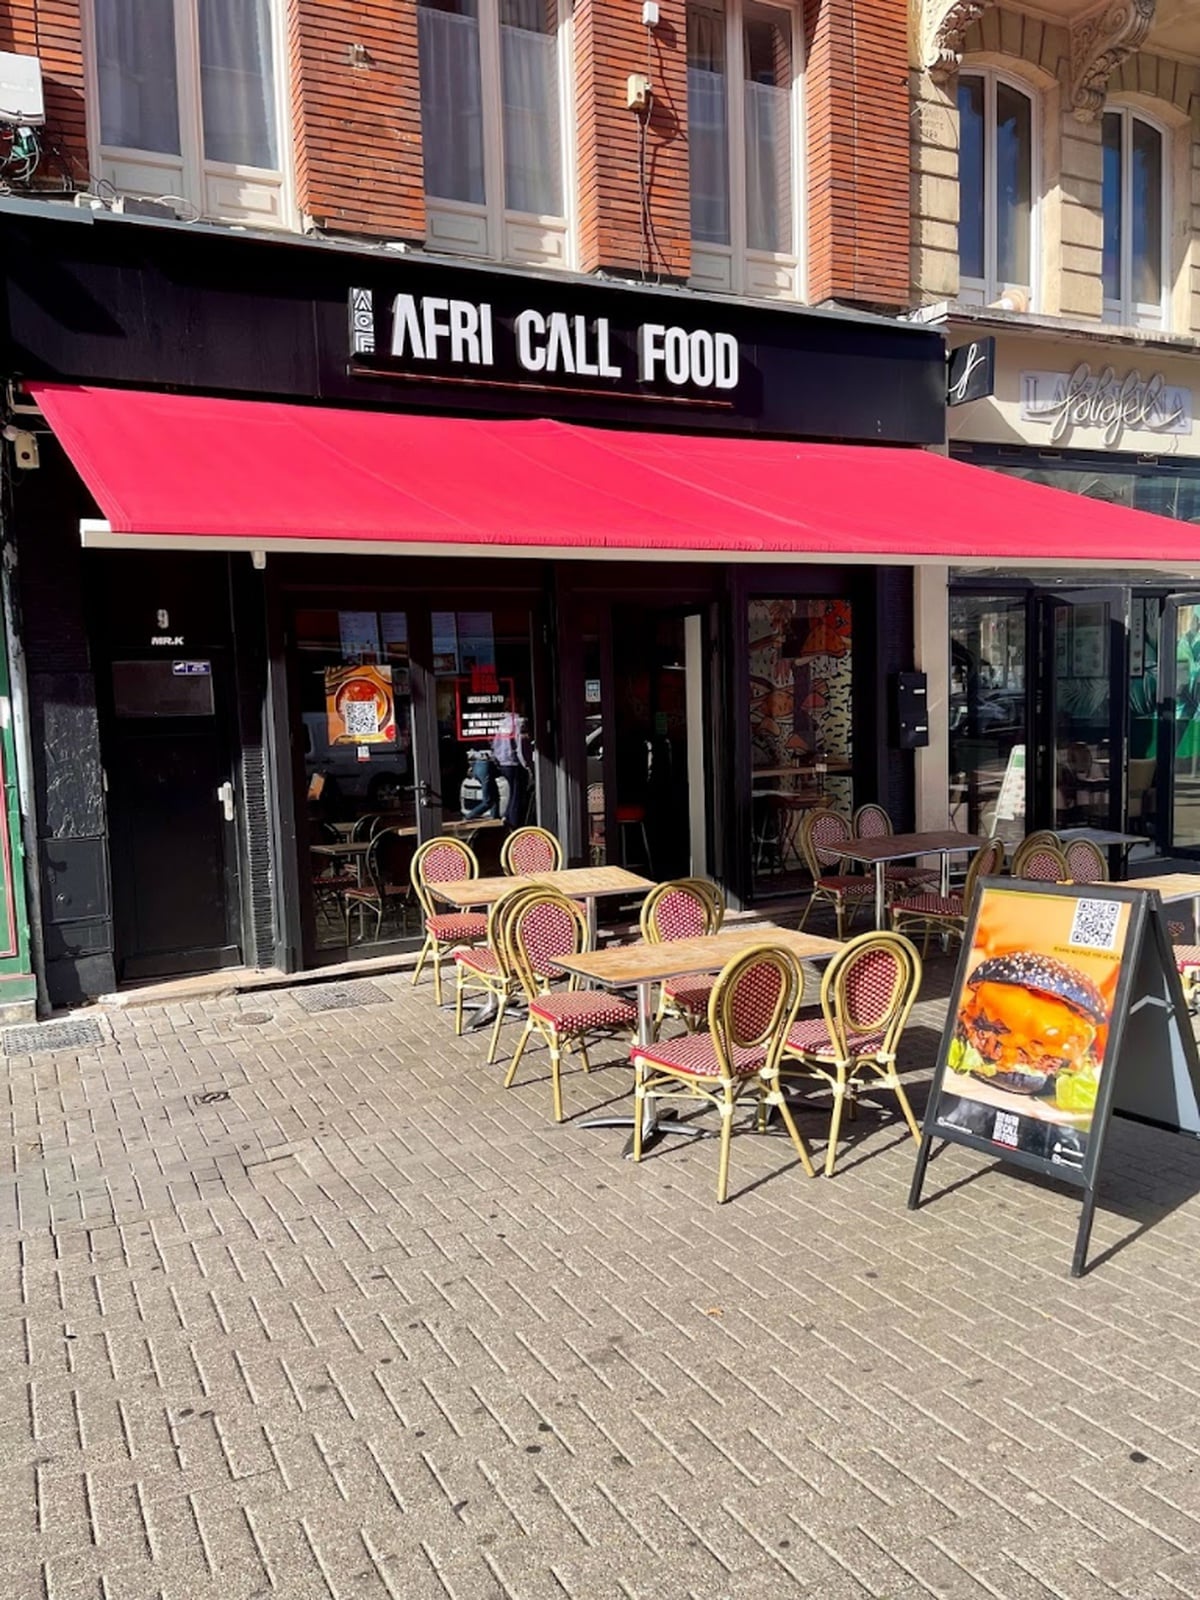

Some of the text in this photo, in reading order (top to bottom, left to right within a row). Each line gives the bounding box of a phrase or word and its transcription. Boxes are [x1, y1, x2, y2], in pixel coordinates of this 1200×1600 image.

[390, 293, 739, 390] AFRI CALL FOOD
[157, 608, 170, 629] 9
